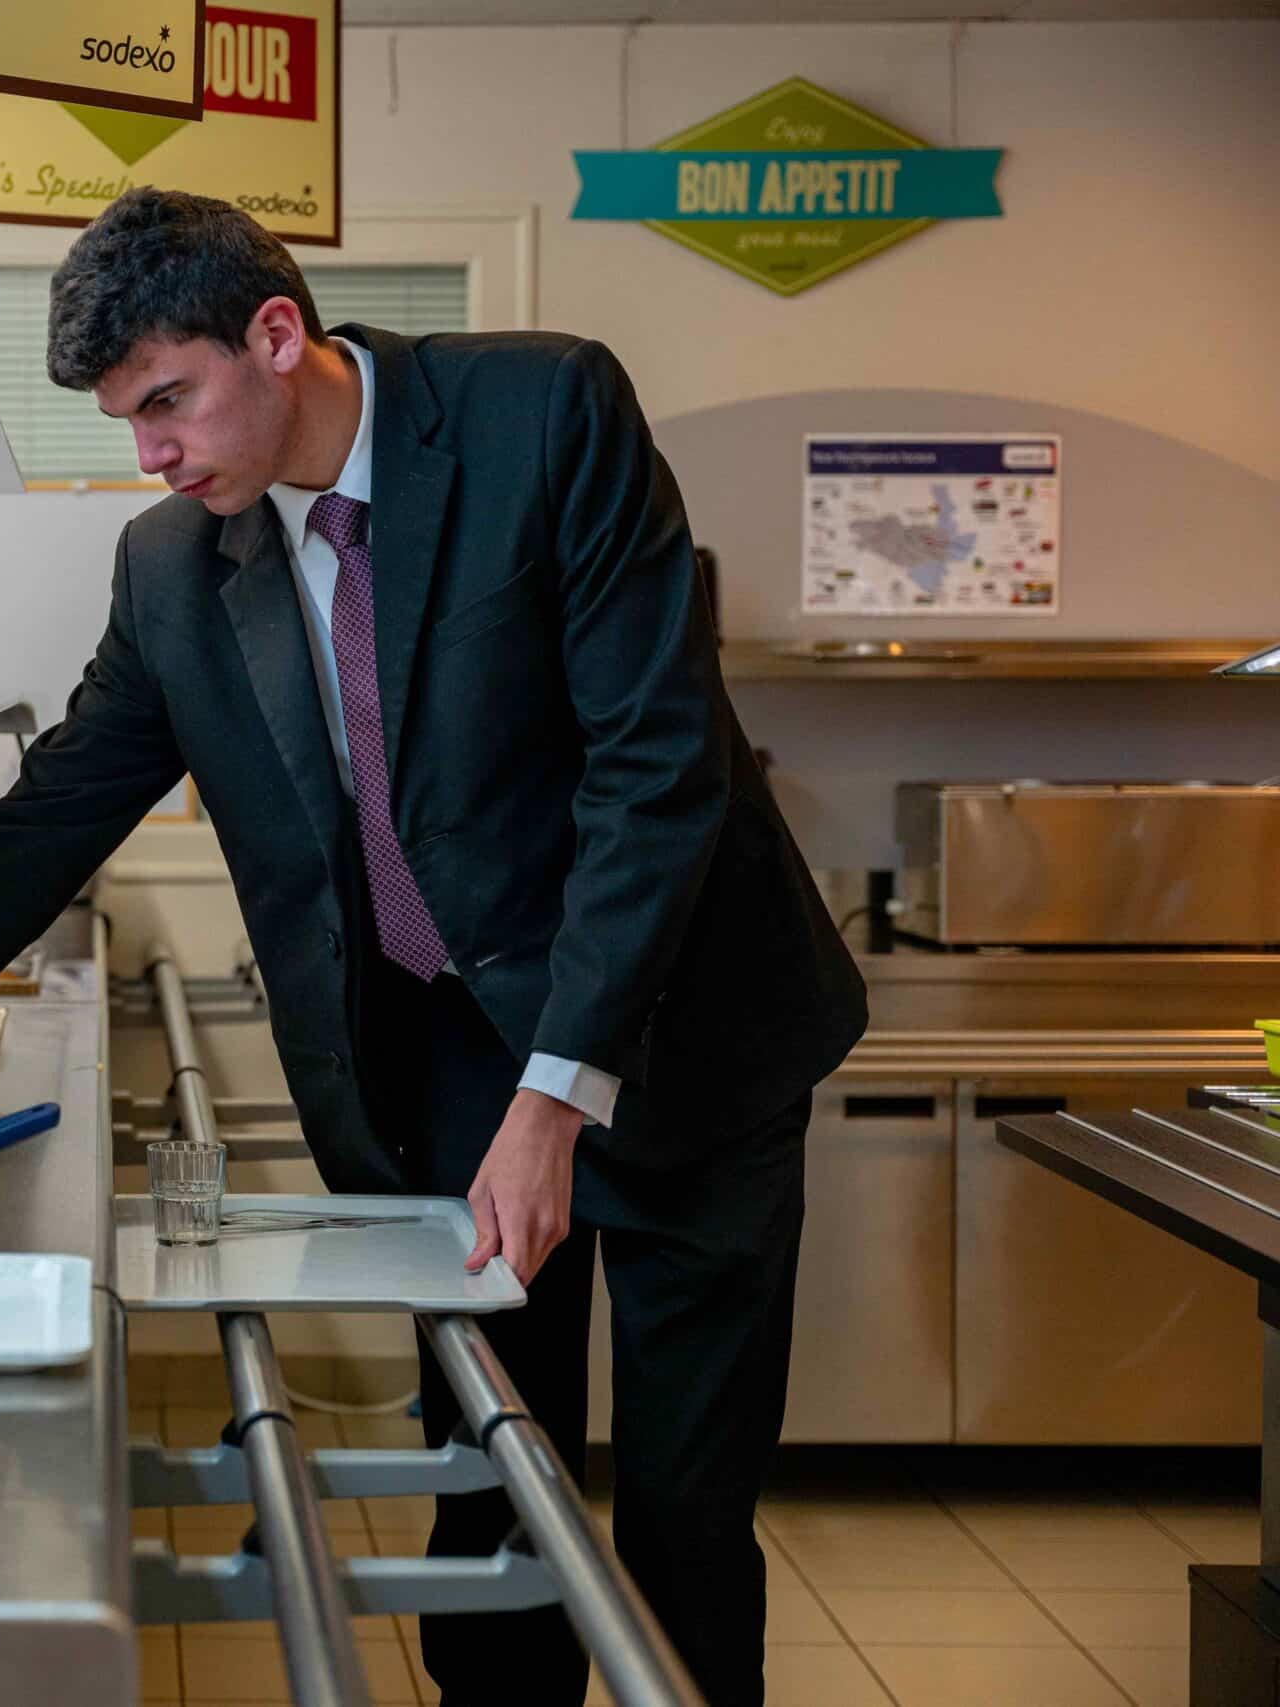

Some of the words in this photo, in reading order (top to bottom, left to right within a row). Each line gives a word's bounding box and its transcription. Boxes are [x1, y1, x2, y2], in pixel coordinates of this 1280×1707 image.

[80, 34, 176, 73] sodexo
[236, 192, 319, 217] sodexo
[677, 160, 750, 213] BON
[757, 159, 901, 214] APPETIT
